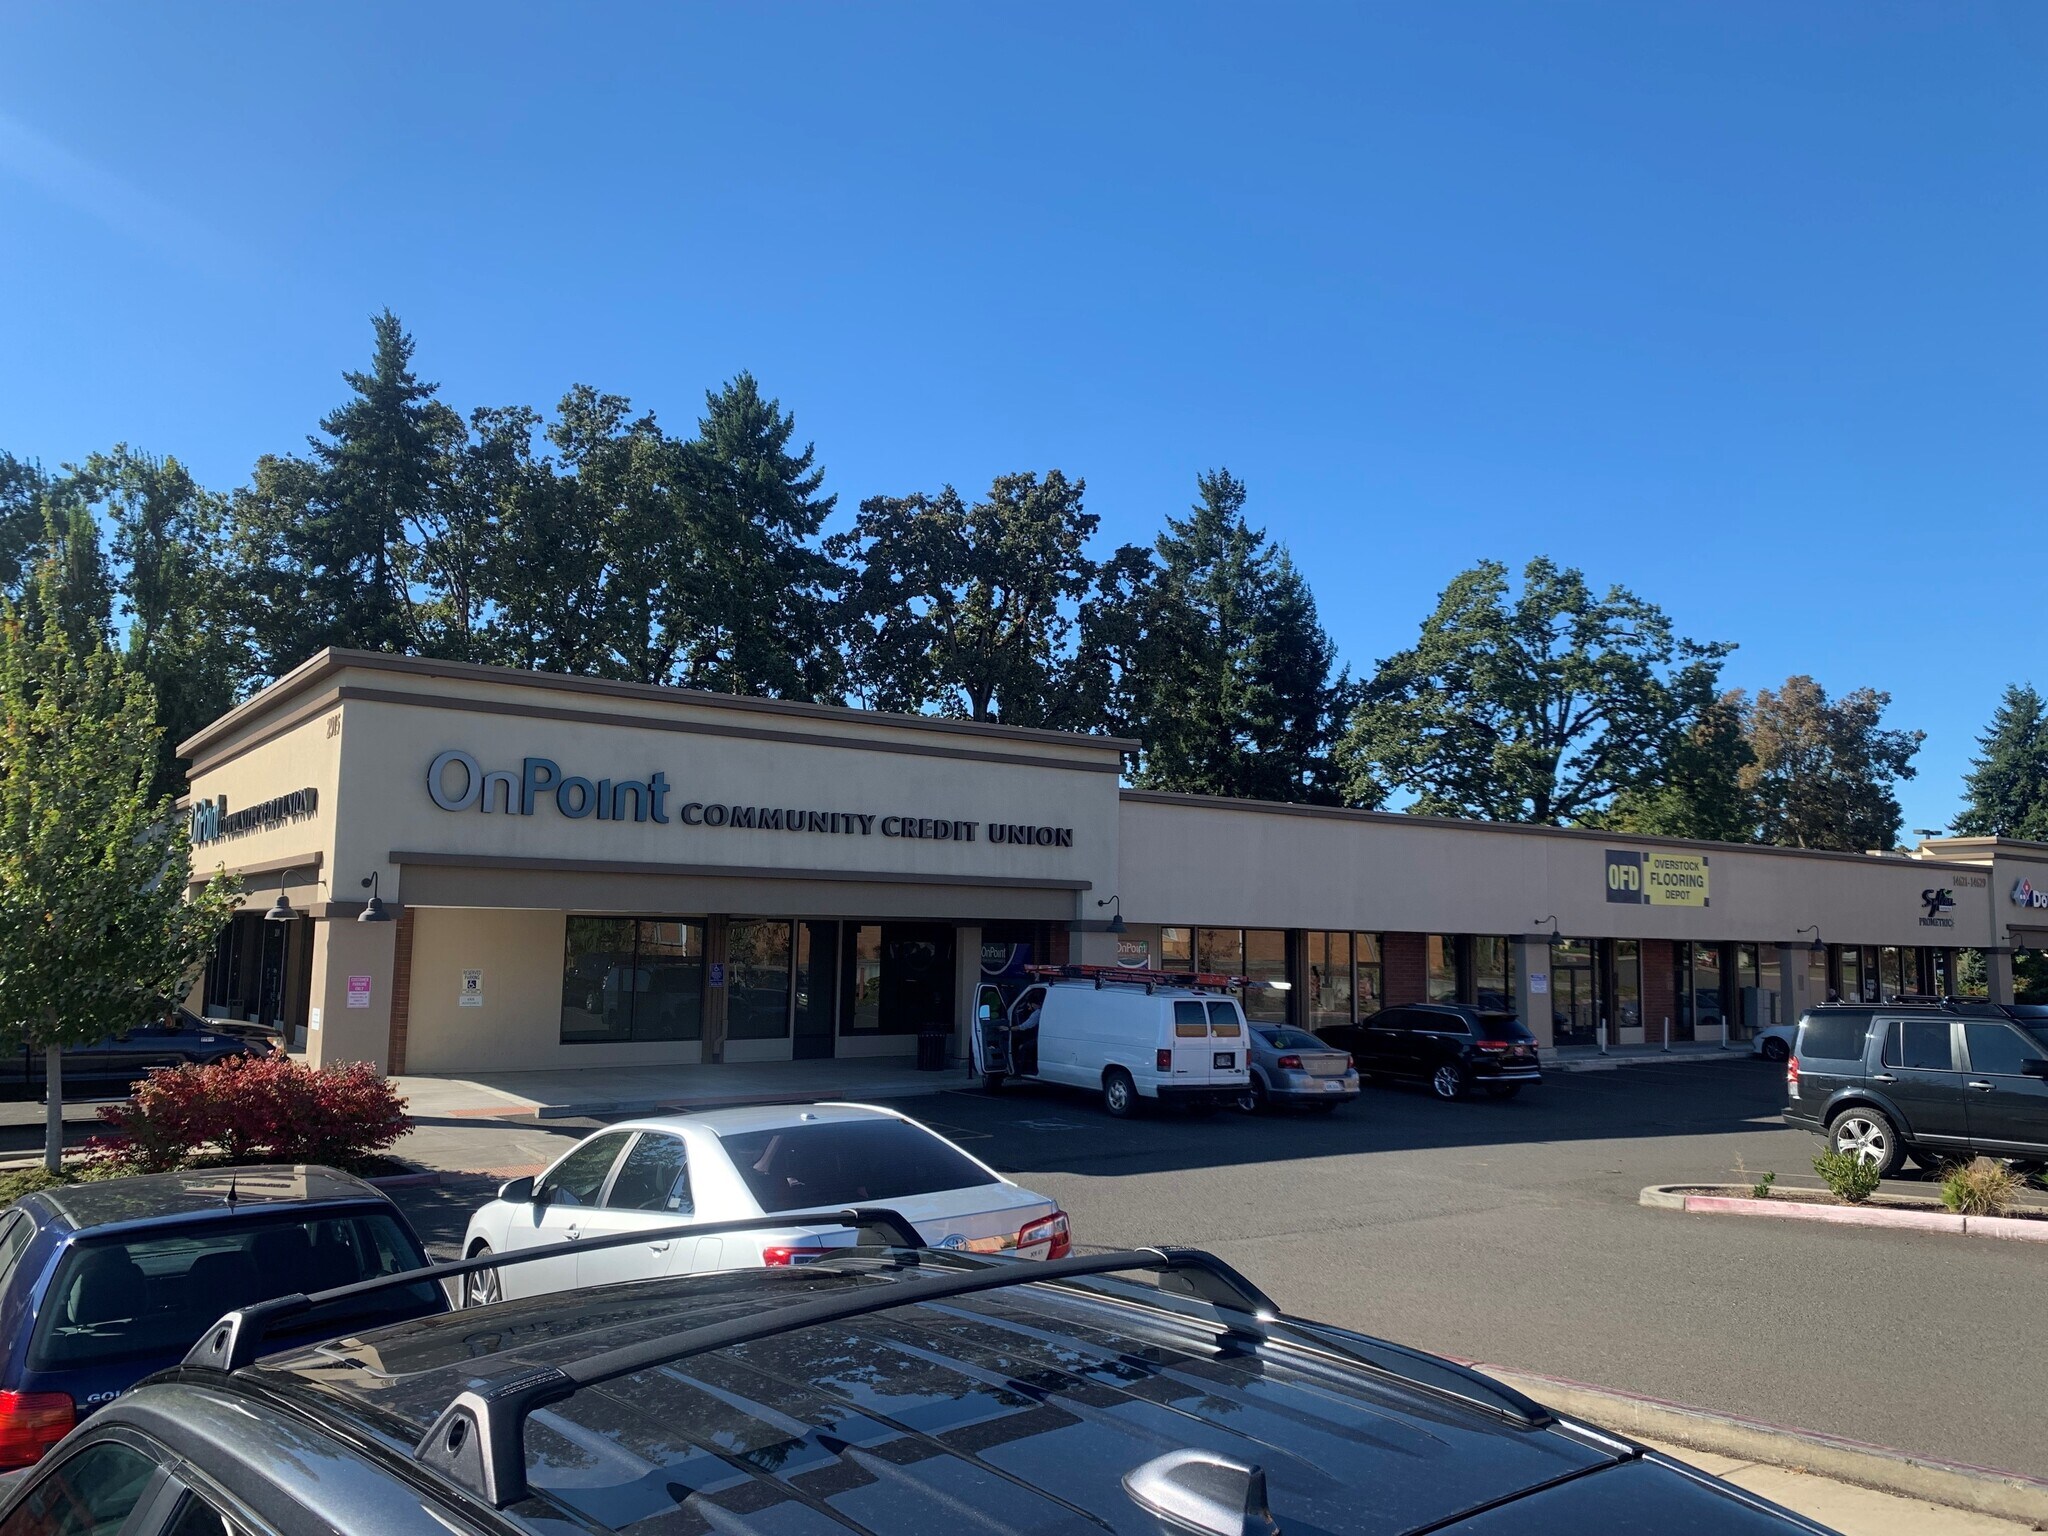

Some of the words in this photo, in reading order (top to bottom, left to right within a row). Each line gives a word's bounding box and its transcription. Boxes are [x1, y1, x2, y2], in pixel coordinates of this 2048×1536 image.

[428, 750, 670, 824] OnPoint
[681, 802, 877, 835] COMMUNITY
[881, 815, 980, 842] CREDIT
[988, 823, 1074, 847] UNION
[1654, 860, 1700, 872] OVERSTOCK
[1608, 864, 1640, 891] OFD
[1650, 872, 1705, 888] FLOORING
[1665, 889, 1691, 900] DEPOT
[87, 1390, 120, 1404] GO
